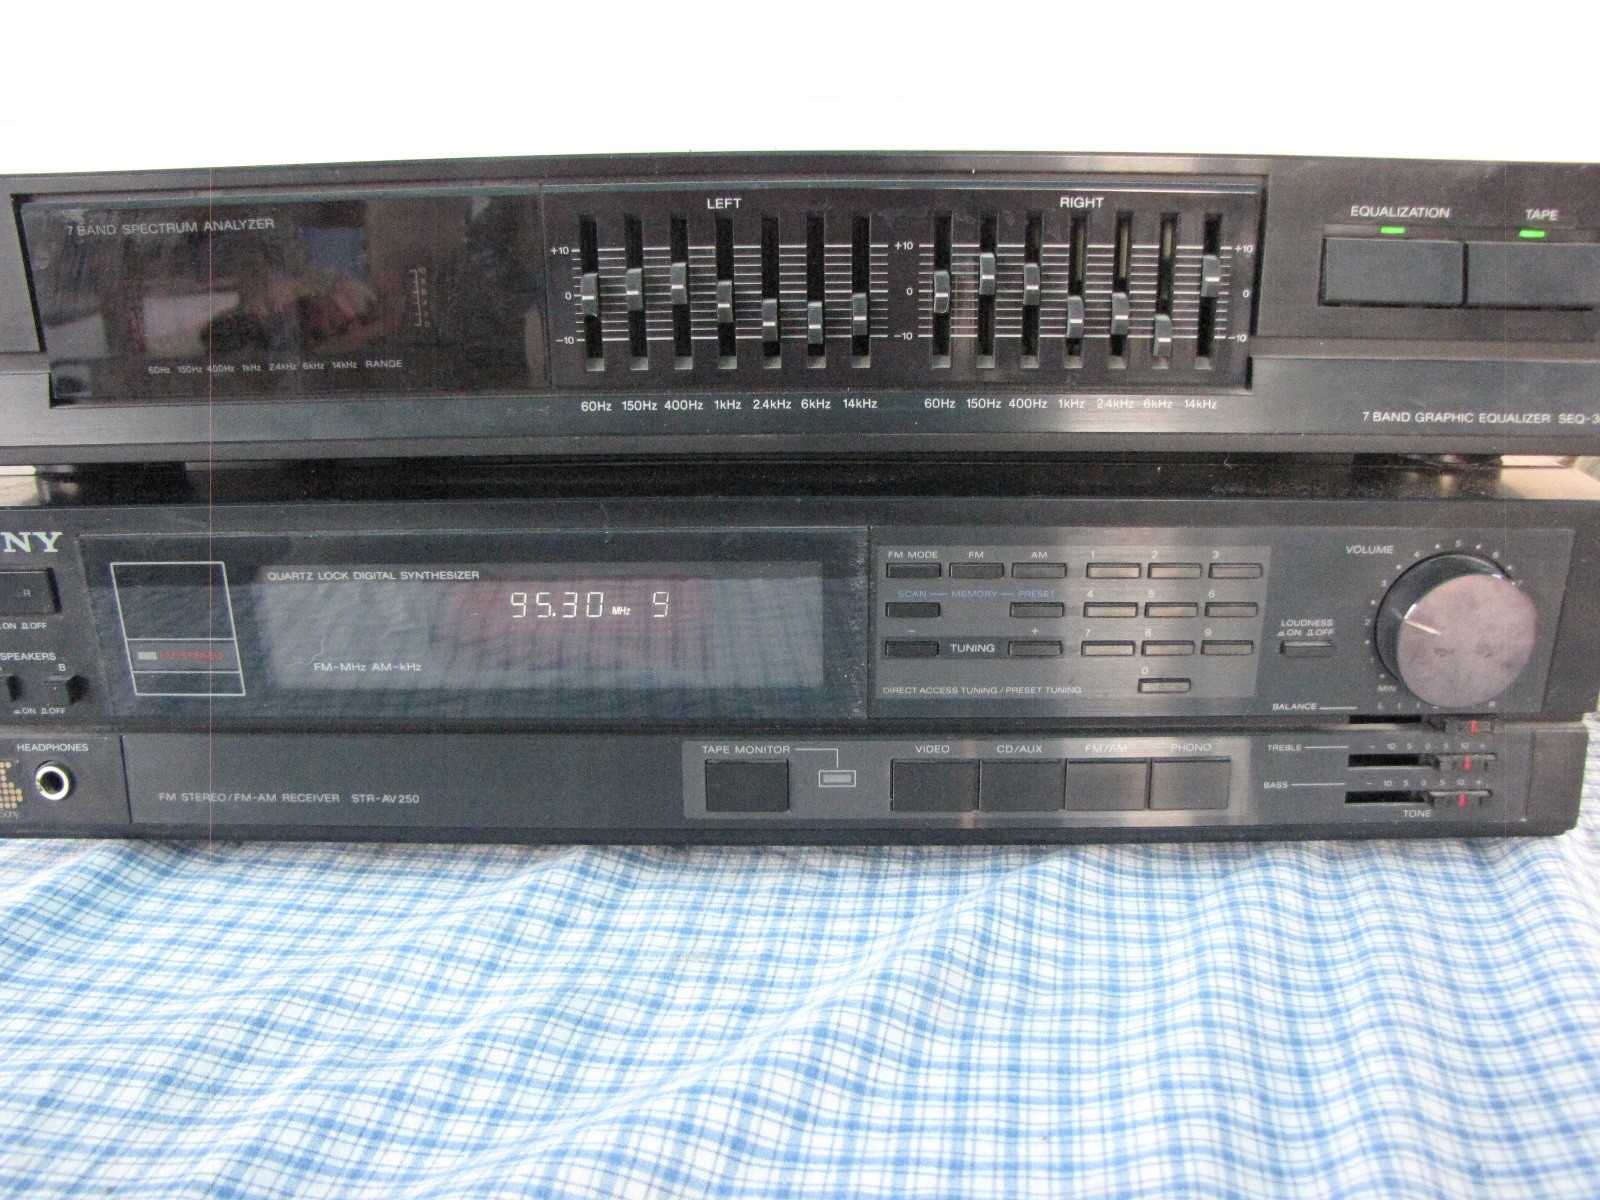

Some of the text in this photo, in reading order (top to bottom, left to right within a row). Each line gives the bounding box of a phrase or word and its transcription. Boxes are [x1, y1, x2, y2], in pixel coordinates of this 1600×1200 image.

[706, 198, 743, 210] LEFT
[1059, 197, 1104, 209] RIGHT
[1350, 205, 1450, 219] EQUALIZATION
[1525, 208, 1559, 222] TAPE
[67, 218, 276, 236] 7 BAND SPECTRUM ANALYZER
[893, 241, 914, 251] +10
[1234, 244, 1254, 254] +10
[550, 246, 570, 256] +10
[302, 361, 325, 370] 6kHz
[365, 359, 403, 369] RANGE
[581, 399, 878, 412] 60Hz 150Hz 400Hz 1kHz 2.4kHz 6kHz 14kHz
[923, 398, 1218, 410] 60Hz 150Hz 400Hz 1kHz 2.4kHz 6kHz 14kHz
[1362, 411, 1370, 422] 7
[1372, 412, 1411, 423] BAND
[1414, 412, 1474, 424] GRAPHIC
[1478, 412, 1551, 424] EQUALIZER
[1090, 550, 1096, 559] 1
[1212, 550, 1219, 559] 3
[1345, 545, 1395, 555] VOLUME
[887, 551, 938, 559] FM MODE
[968, 551, 984, 559] FM
[1031, 551, 1048, 559] AM
[1151, 551, 1158, 559] 2
[267, 570, 480, 581] QUARTZ LOCK DIGITAL SYNTHESIZER
[898, 590, 1056, 598] SCAN MEMORY PRESET
[1086, 589, 1094, 599] 4
[1148, 589, 1156, 598] 5
[1208, 589, 1216, 598] 6
[510, 592, 631, 618] 95.30 MHz
[652, 591, 669, 618] 9
[2, 622, 48, 630] ON OFF
[1281, 618, 1333, 627] LOUDNESS
[1364, 618, 1371, 626] 2
[1085, 628, 1091, 637] 7
[1144, 628, 1152, 637] 8
[1204, 628, 1212, 637] 9
[1286, 629, 1335, 637] ON OFF
[950, 643, 995, 653] TUNING
[0, 652, 57, 661] SPEAKERS
[58, 663, 67, 672] B
[313, 662, 422, 672] FM-MHz AM-kHz
[1141, 667, 1149, 675] 0
[882, 686, 917, 695] DIRECT
[919, 686, 958, 695] ACCESS
[961, 686, 998, 695] TUNING
[1005, 686, 1041, 695] PRESET
[1046, 686, 1082, 695] TUNING
[1377, 684, 1397, 693] MIN
[22, 707, 66, 715] ON OFF
[1272, 702, 1317, 711] BALANCE
[17, 743, 89, 752] HEADPHONES
[702, 745, 791, 754] TAPE MONITOR
[915, 744, 950, 753] VIDEO
[996, 744, 1043, 753] CD/AUX
[1085, 744, 1127, 753] FM/AM
[1171, 743, 1212, 752] PHONO
[1268, 744, 1302, 752] TREBLE
[1263, 781, 1288, 789] BASS
[158, 793, 177, 801] FM
[282, 793, 340, 802] RECEIVER
[1403, 809, 1431, 818] TONE
